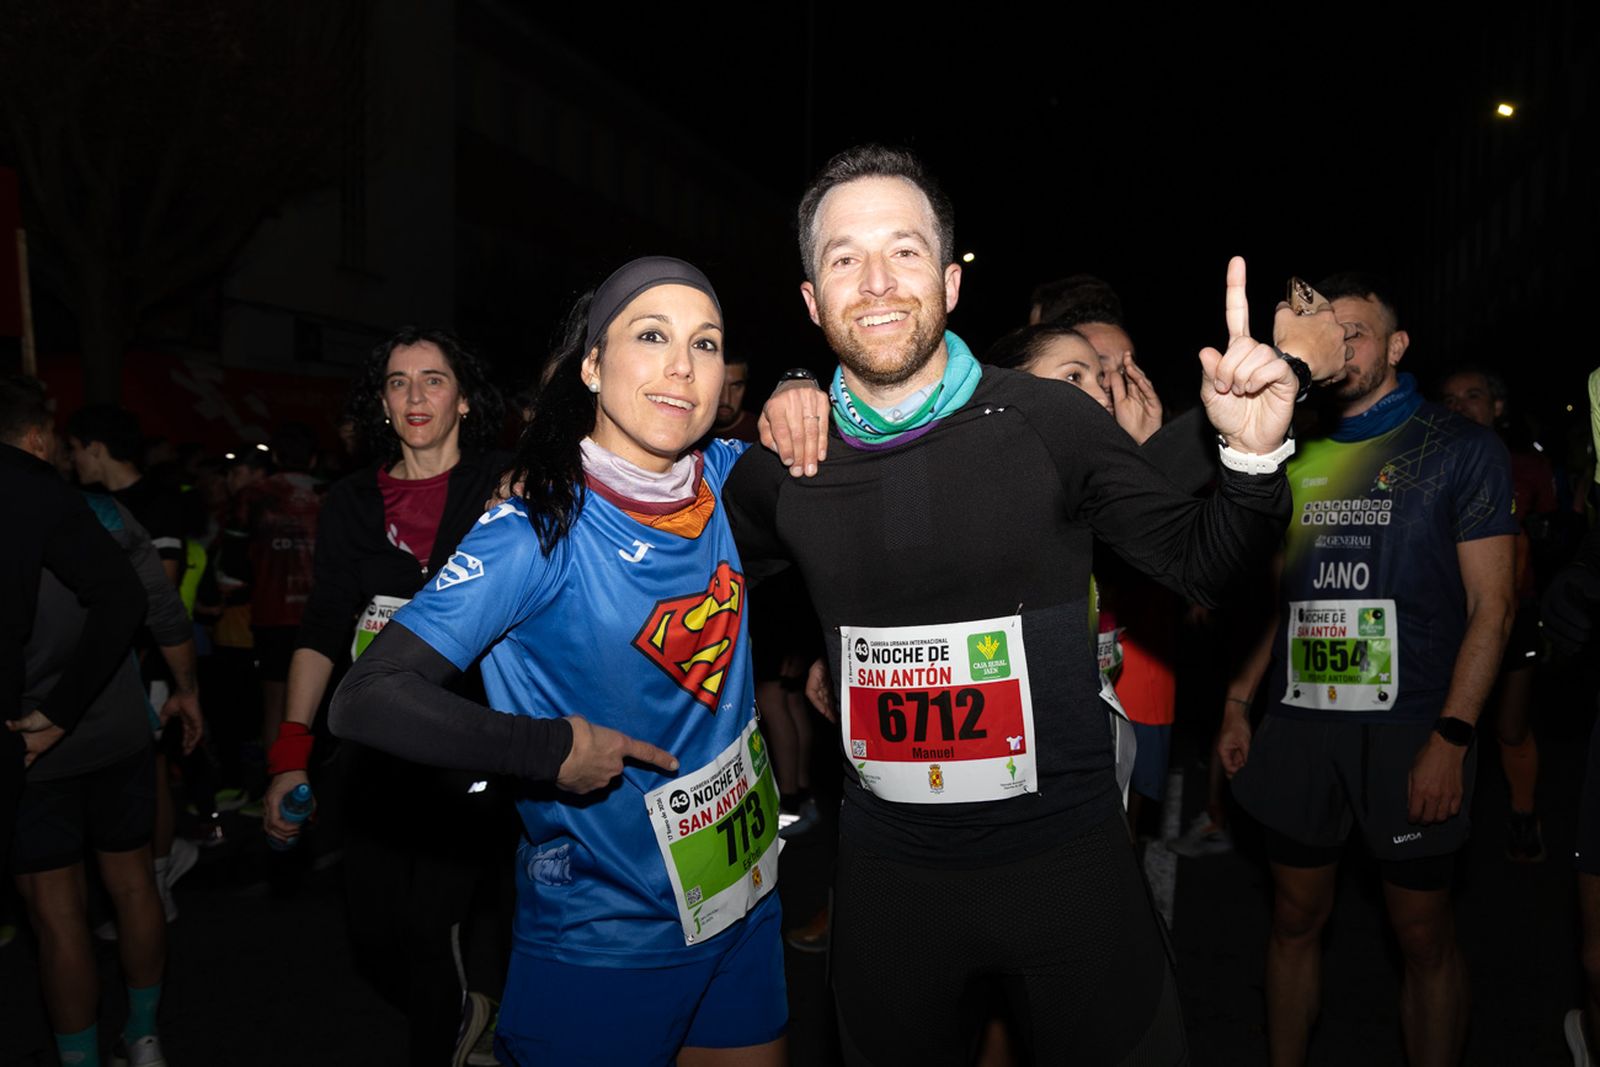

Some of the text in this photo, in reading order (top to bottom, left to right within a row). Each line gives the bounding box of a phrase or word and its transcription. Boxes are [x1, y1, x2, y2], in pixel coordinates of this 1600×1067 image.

[1313, 561, 1370, 591] JANO
[1332, 612, 1346, 623] DE
[1310, 624, 1346, 637] ANTÓN
[855, 642, 868, 656] 43
[872, 645, 949, 664] NOCHE DE
[1303, 641, 1370, 672] 1654
[858, 663, 951, 687] SAN ANTÓN
[878, 688, 988, 742] 6712
[912, 747, 954, 759] Manuel
[693, 768, 733, 808] NOCHE
[733, 757, 745, 778] DE
[671, 793, 689, 809] 43
[678, 775, 749, 837] SAN ANTÓN
[716, 790, 766, 867] 773
